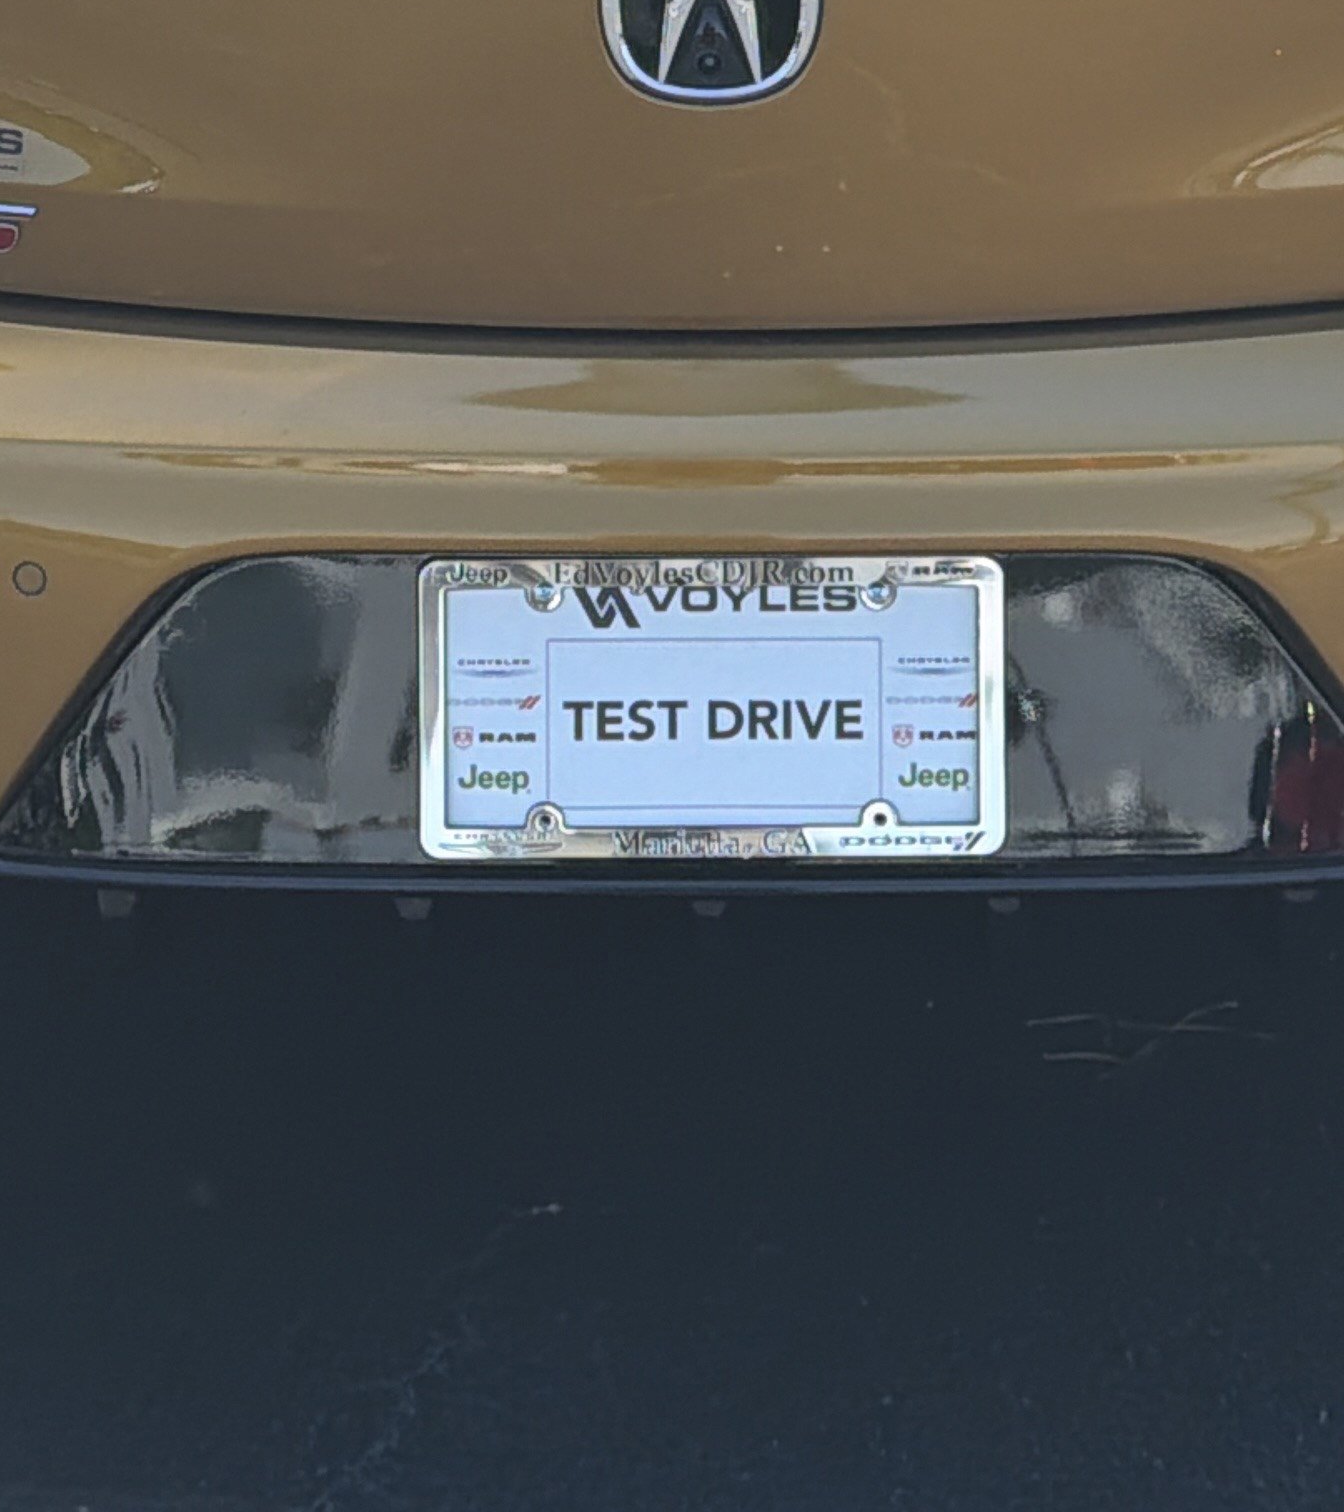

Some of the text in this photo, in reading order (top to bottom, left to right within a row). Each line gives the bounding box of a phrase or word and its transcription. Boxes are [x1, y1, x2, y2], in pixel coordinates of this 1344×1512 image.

[448, 563, 509, 586] Jeep
[644, 585, 858, 612] VOYLES
[563, 698, 864, 741] TEST DRIVE
[478, 731, 537, 743] RAM
[918, 729, 976, 741] RAM
[458, 763, 530, 794] Jeep
[897, 762, 970, 792] Jeep
